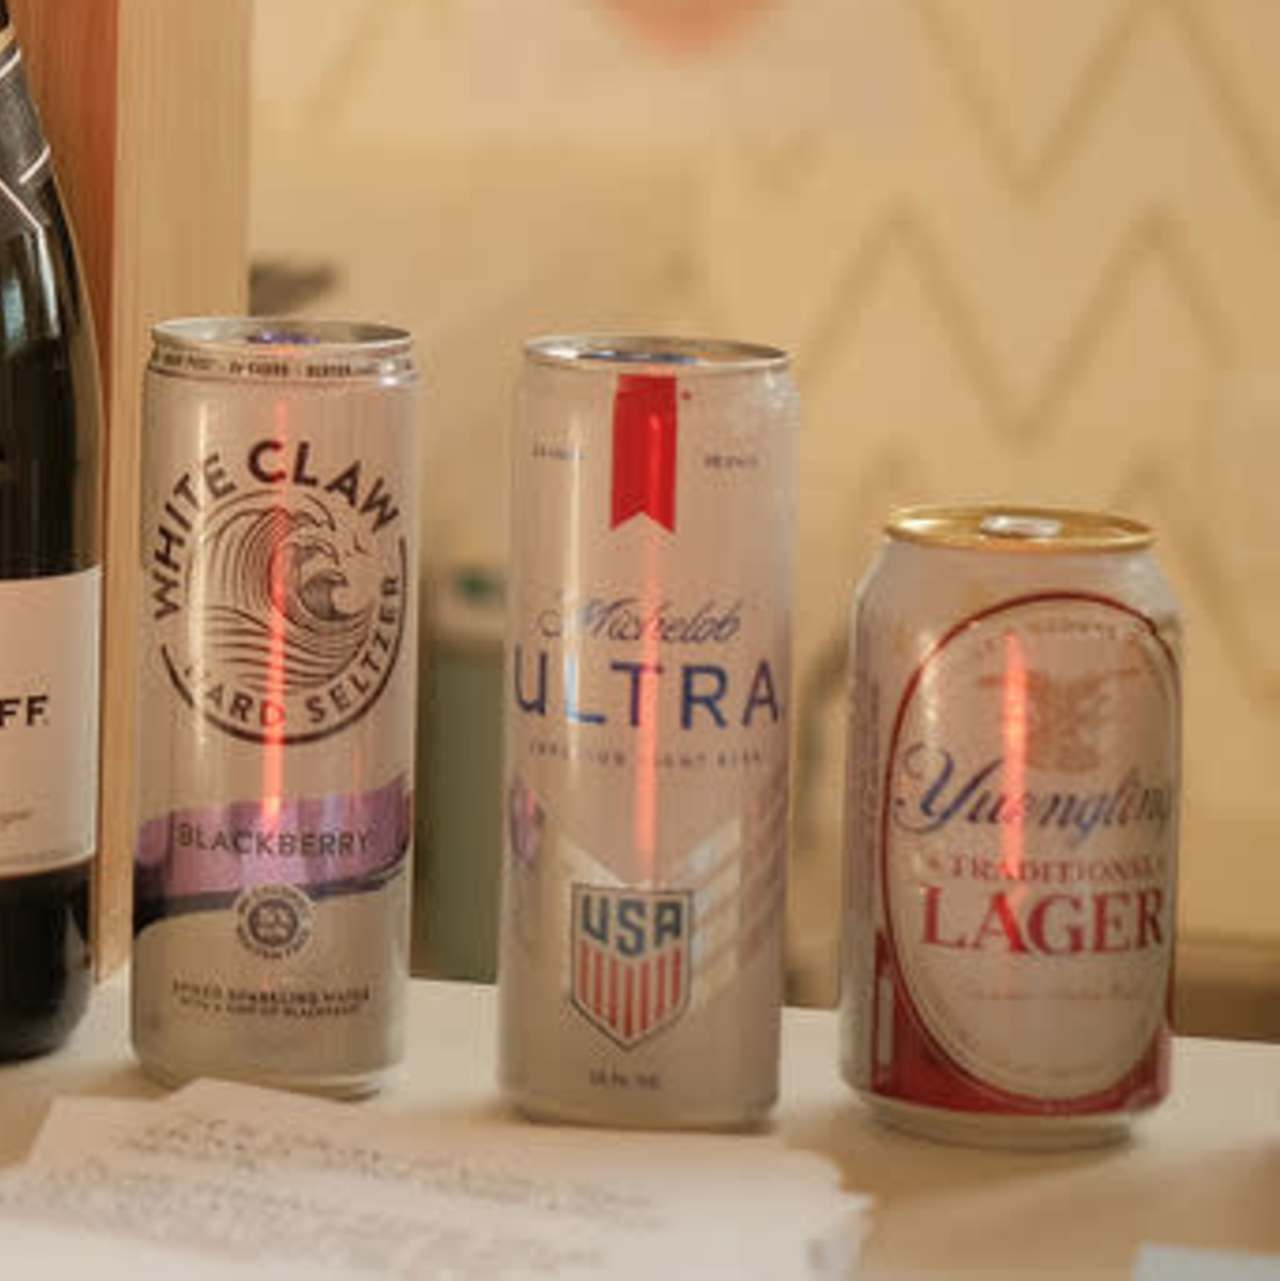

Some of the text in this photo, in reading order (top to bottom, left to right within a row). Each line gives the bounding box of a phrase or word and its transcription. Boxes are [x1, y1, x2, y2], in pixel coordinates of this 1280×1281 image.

[151, 438, 401, 622] WHITE CLAW
[303, 576, 401, 725] SELTZER
[513, 642, 780, 731] ULTRA
[176, 822, 371, 857] BLACKBERRY
[580, 894, 684, 959] USA
[917, 880, 1167, 956] LAGER
